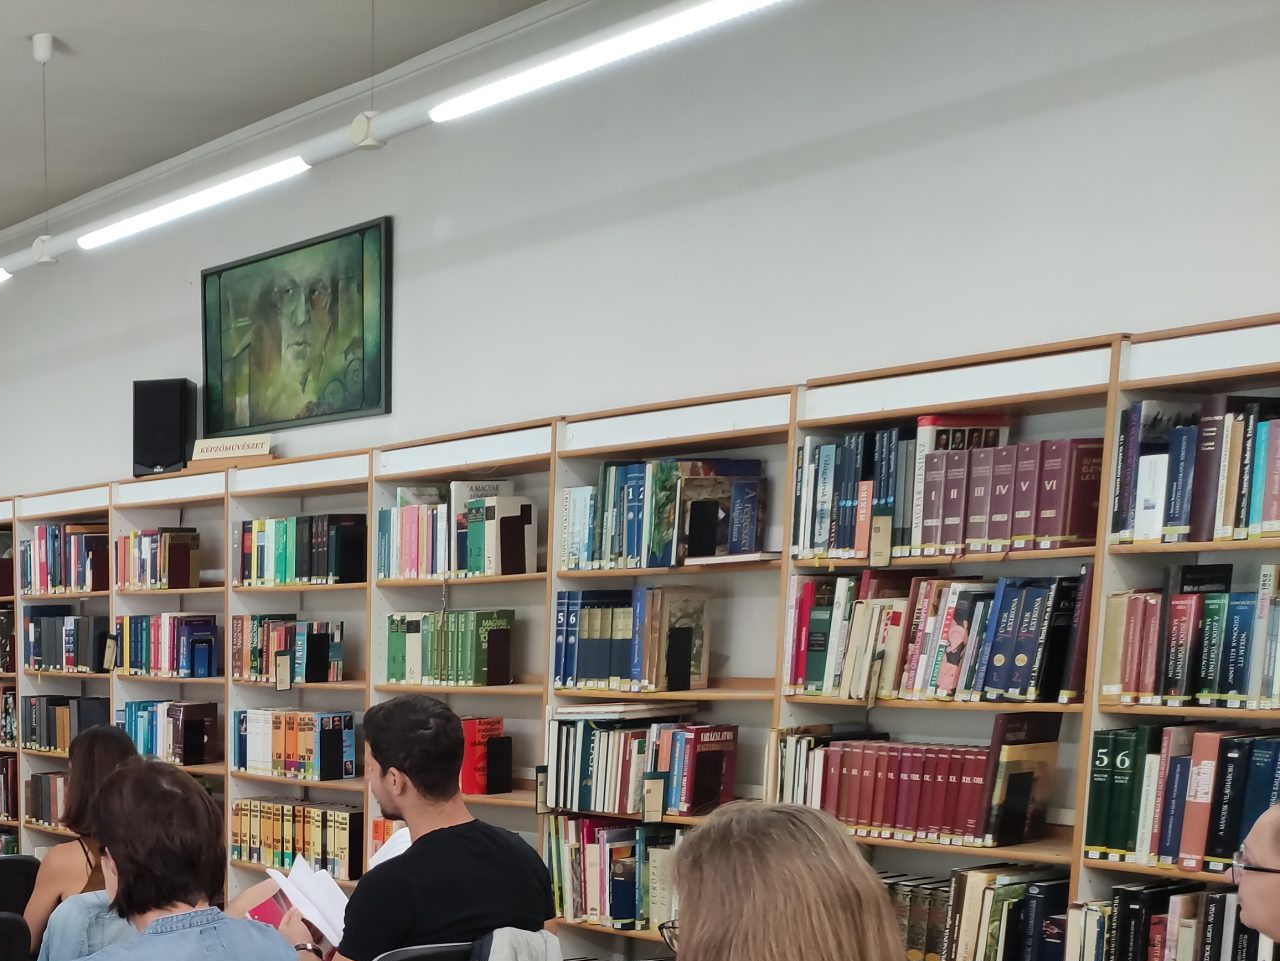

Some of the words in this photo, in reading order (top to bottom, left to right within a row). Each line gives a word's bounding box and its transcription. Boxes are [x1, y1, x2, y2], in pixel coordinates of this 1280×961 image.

[995, 485, 1008, 495] IV
[1020, 481, 1029, 492] V
[1044, 480, 1057, 491] VI
[745, 488, 756, 499] A
[740, 504, 754, 551] régészet
[557, 612, 564, 624] 5
[569, 613, 576, 625] 6
[1095, 749, 1108, 767] 5
[1116, 750, 1130, 769] 6
[1219, 803, 1228, 830] MÁSODIK
